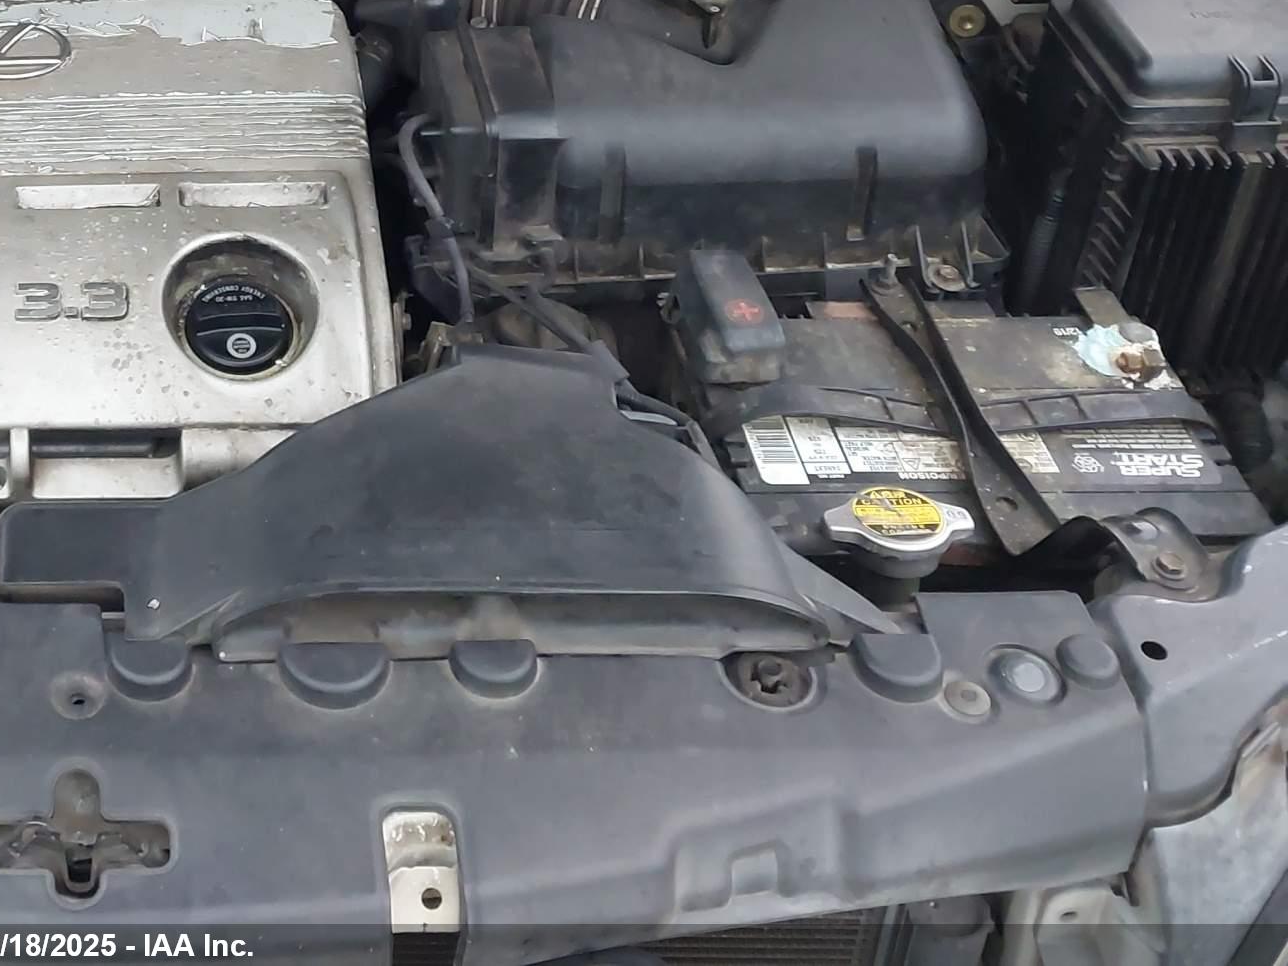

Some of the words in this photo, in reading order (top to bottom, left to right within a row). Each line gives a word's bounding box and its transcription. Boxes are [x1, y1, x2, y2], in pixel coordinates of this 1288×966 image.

[14, 280, 130, 322] 3.3
[1112, 452, 1204, 468] START
[1120, 464, 1201, 478] SUPER
[862, 497, 922, 505] CTION
